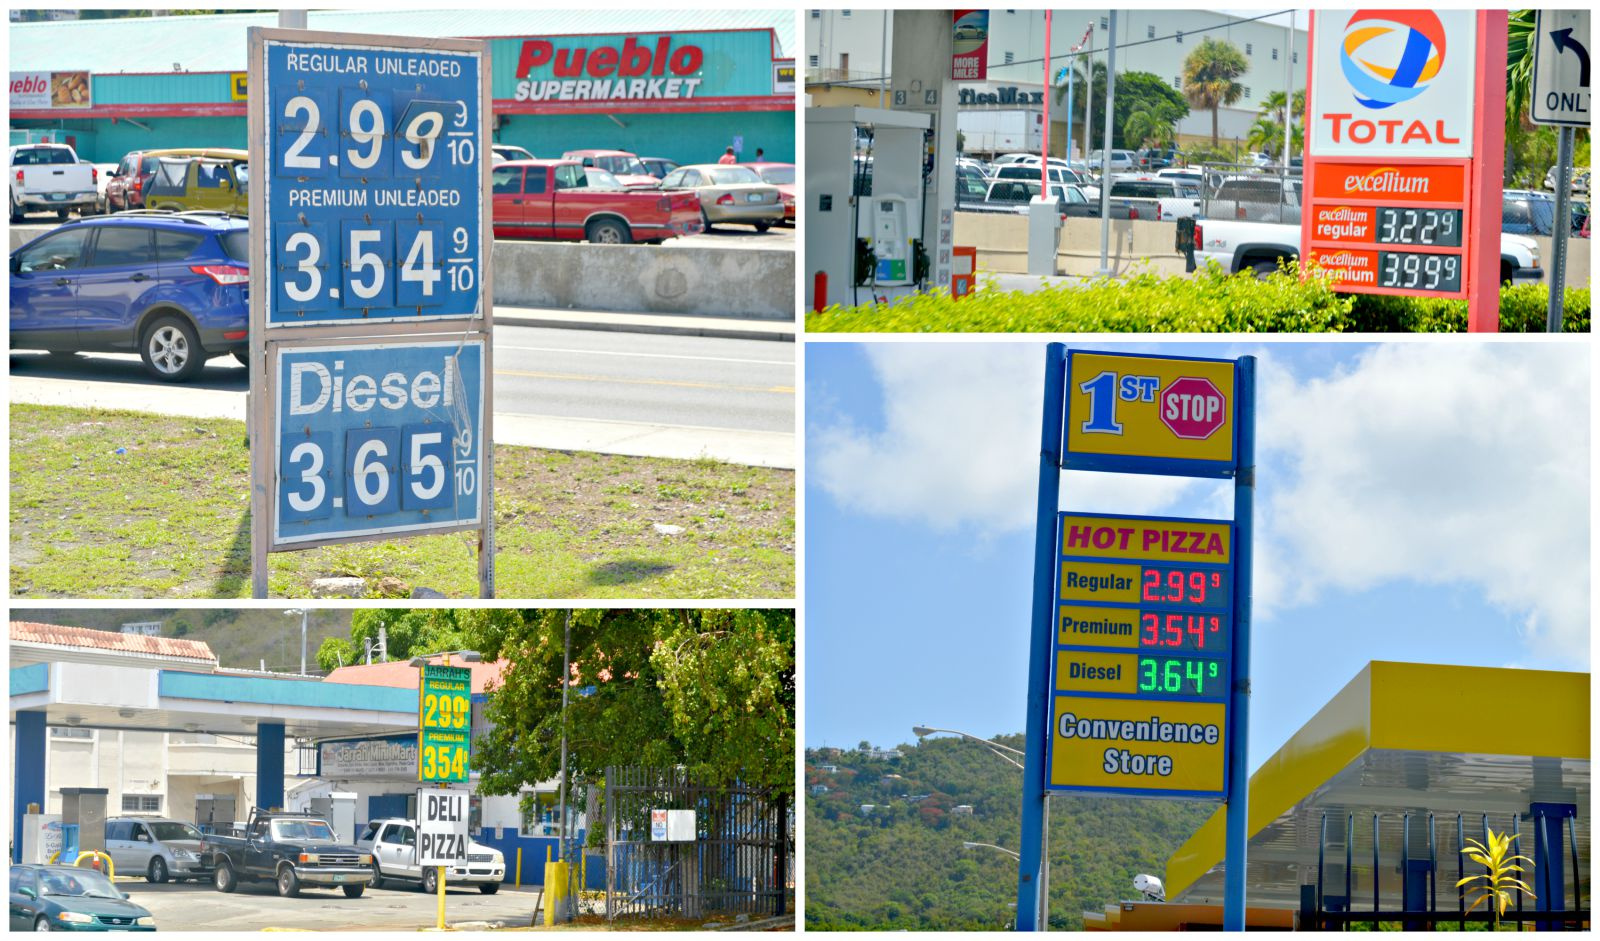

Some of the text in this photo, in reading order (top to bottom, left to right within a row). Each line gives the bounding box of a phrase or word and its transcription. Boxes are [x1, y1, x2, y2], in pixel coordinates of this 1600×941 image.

[287, 53, 461, 77] REGULAR UNLEADED
[515, 36, 703, 79] Pueblo
[953, 57, 979, 68] MORE
[953, 69, 979, 79] MILES
[515, 78, 703, 102] SUPERMARKET
[897, 91, 937, 104] 3 4
[1547, 92, 1591, 112] ONL
[1344, 171, 1429, 194] excellium
[289, 189, 460, 207] PREMIUM UNLEADED
[1319, 209, 1368, 222] excellium
[1317, 221, 1368, 239] regular
[284, 230, 441, 302] 3.54
[1319, 252, 1368, 267] excellium
[290, 356, 453, 416] Diesel
[1166, 393, 1220, 422] STOP
[288, 432, 445, 512] 3.65
[1067, 525, 1225, 556] HOT PIZZA
[1067, 572, 1133, 592] Regular
[1062, 616, 1133, 635] Premium
[1069, 662, 1121, 680] Diesel
[430, 680, 464, 691] REGULAR
[428, 732, 464, 742] PREMIUM
[1058, 712, 1219, 744] Convenience
[391, 743, 415, 761] Mart
[1103, 748, 1173, 776] Store
[428, 795, 462, 822] DELI
[421, 833, 466, 859] PIZZA
